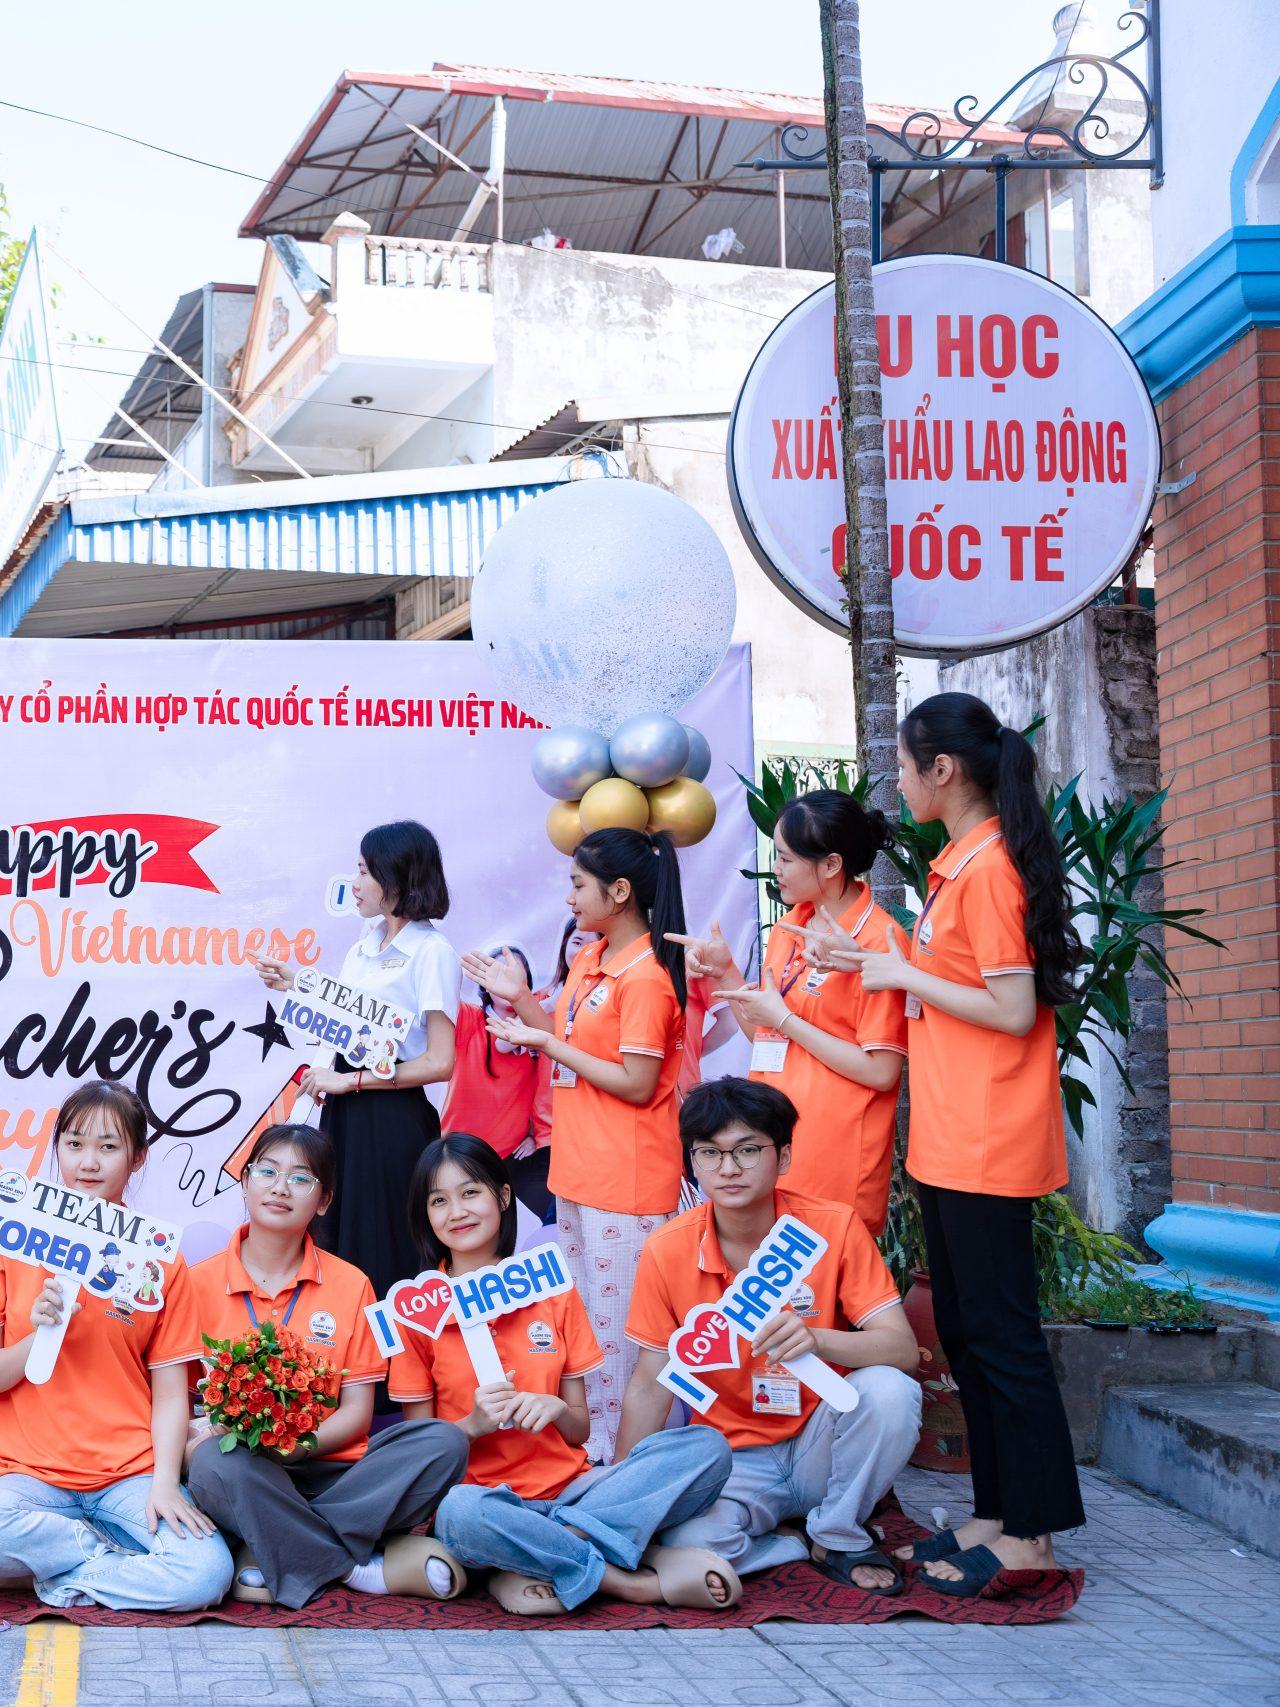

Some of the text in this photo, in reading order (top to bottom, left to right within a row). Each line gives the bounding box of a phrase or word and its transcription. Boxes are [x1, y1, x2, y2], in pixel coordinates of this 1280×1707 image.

[936, 314, 1060, 393] HỌC
[771, 392, 1128, 497] XUẤ HẨU LAO ĐỘNG
[1001, 508, 1069, 582] TẾ
[20, 679, 53, 723] CỔ
[58, 682, 128, 724] PHẦN
[135, 692, 188, 732] HỢP
[193, 688, 240, 726] TÁC
[246, 684, 314, 730] QUỐC
[319, 684, 350, 727] TẾ
[355, 698, 432, 728] HASHI
[438, 692, 495, 736] VIỆT
[9, 898, 322, 977] Vietnamese
[280, 998, 353, 1050] KOREA
[318, 977, 391, 1027] TEAM
[32, 1181, 146, 1245] TEAM
[374, 1249, 566, 1348] I LOVE HASHI
[684, 1313, 729, 1364] LOVE
[722, 1223, 819, 1333] HASHI
